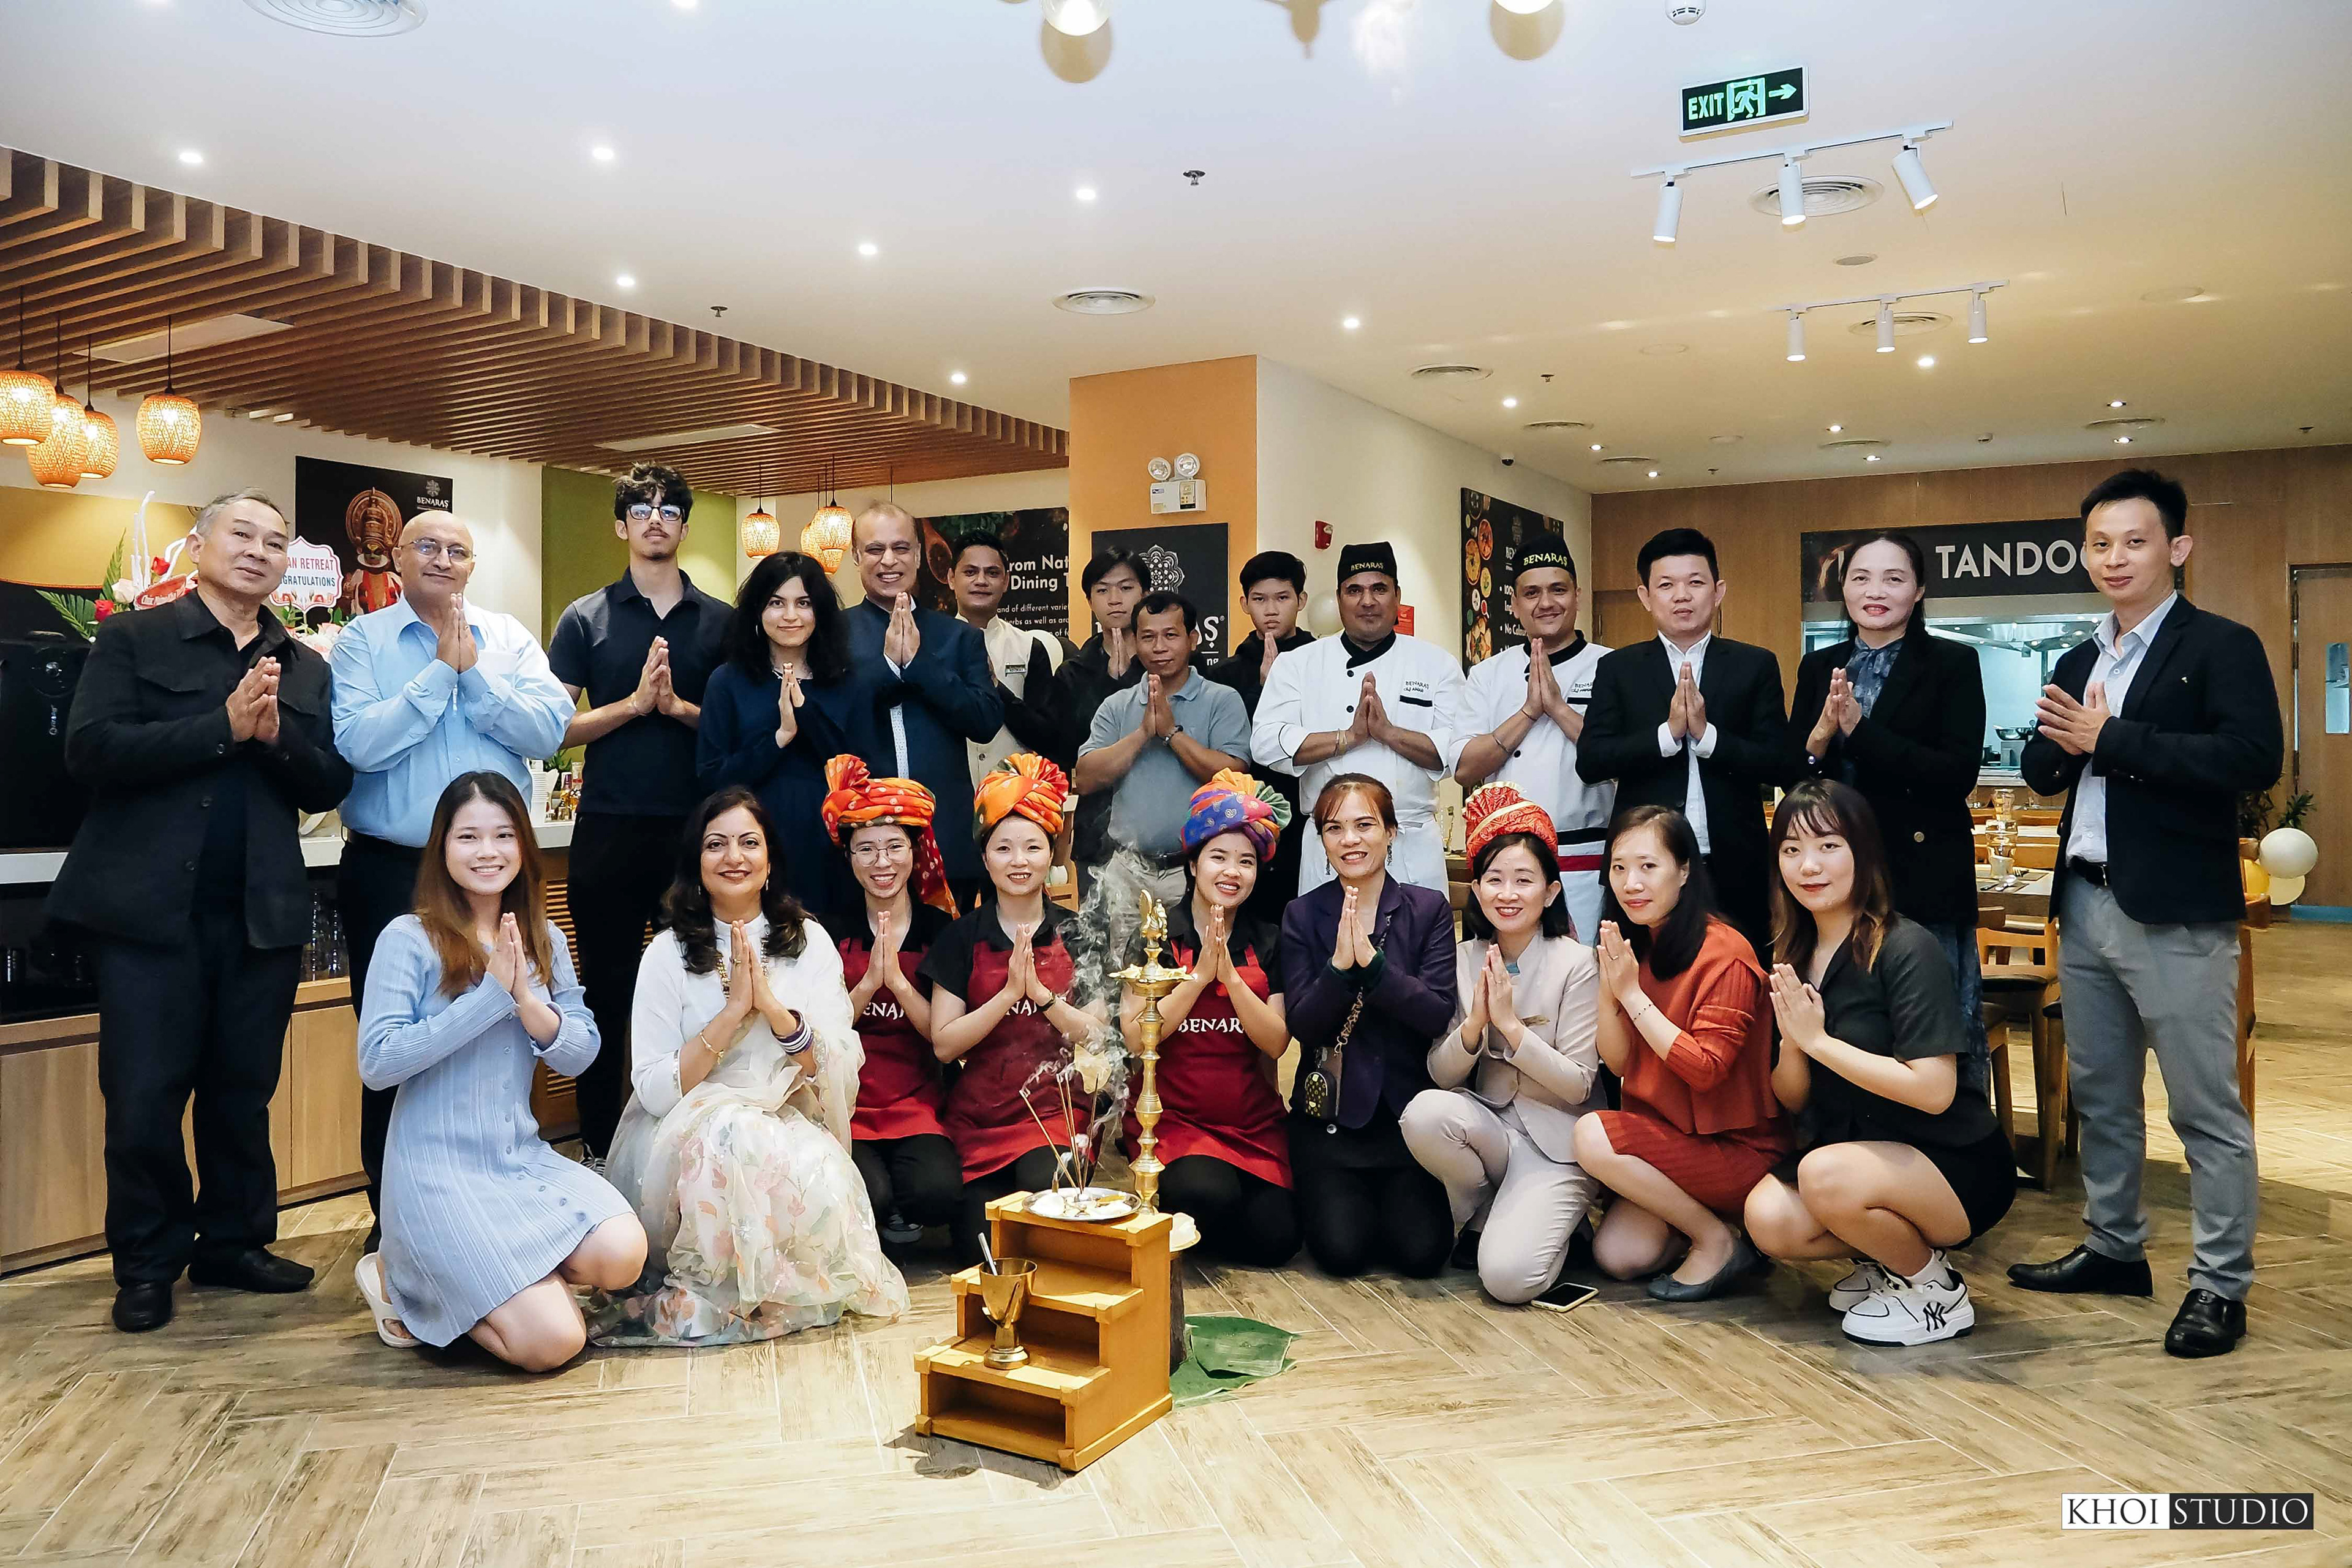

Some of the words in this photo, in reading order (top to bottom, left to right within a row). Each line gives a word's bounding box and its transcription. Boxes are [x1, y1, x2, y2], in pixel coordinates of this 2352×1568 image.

[1688, 92, 1724, 120] EXIT
[287, 557, 297, 568] AN
[300, 558, 334, 570] RETREAT
[1008, 560, 1036, 572] rom
[1042, 554, 1069, 570] Nat
[1351, 562, 1384, 571] BENARAS
[1523, 552, 1567, 567] BENARAS
[1935, 540, 2087, 579] TANDO
[282, 575, 336, 587] GRATULATIONS
[1011, 575, 1058, 592] Dining
[1034, 616, 1047, 624] well
[1178, 1017, 1244, 1033] BENAR
[1923, 1301, 1947, 1333] NY
